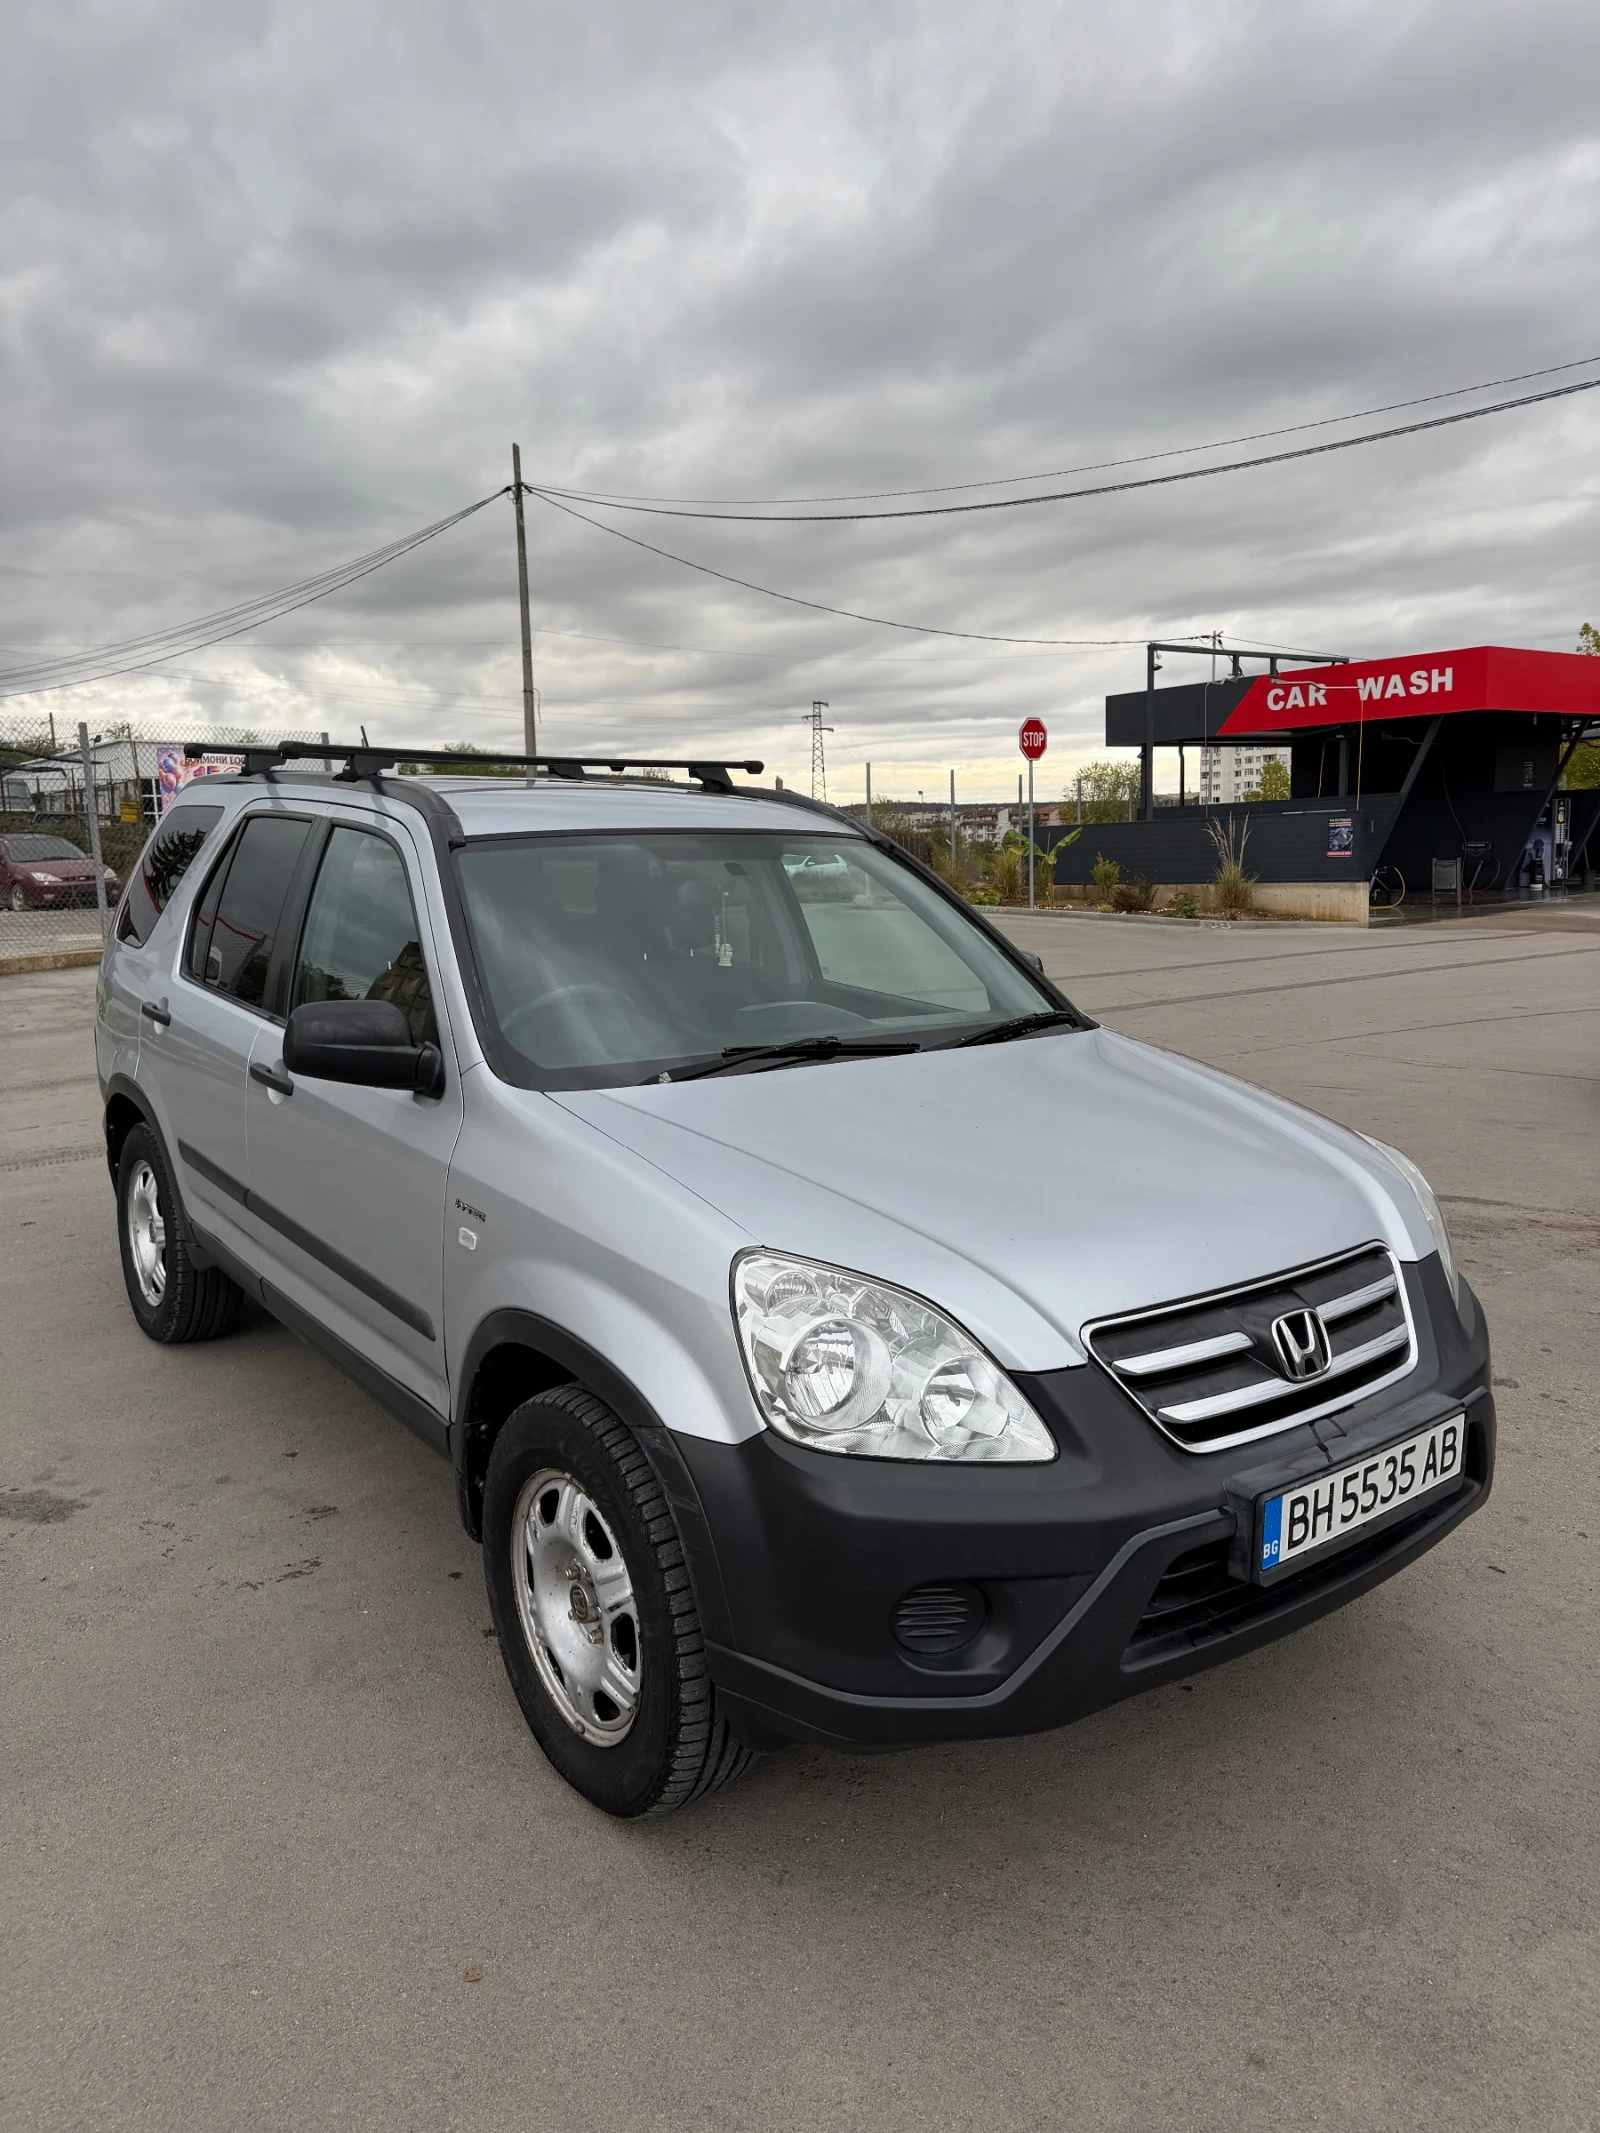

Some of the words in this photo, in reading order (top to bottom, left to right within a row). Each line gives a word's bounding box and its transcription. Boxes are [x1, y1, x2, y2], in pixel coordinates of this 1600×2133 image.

[1267, 683, 1327, 711] CAR
[1356, 667, 1453, 701] WASH
[1023, 732, 1044, 746] STOP
[1287, 1482, 1335, 1550] BH
[1340, 1444, 1416, 1524] 5535
[1421, 1425, 1458, 1486] AB
[1263, 1540, 1279, 1559] BG
